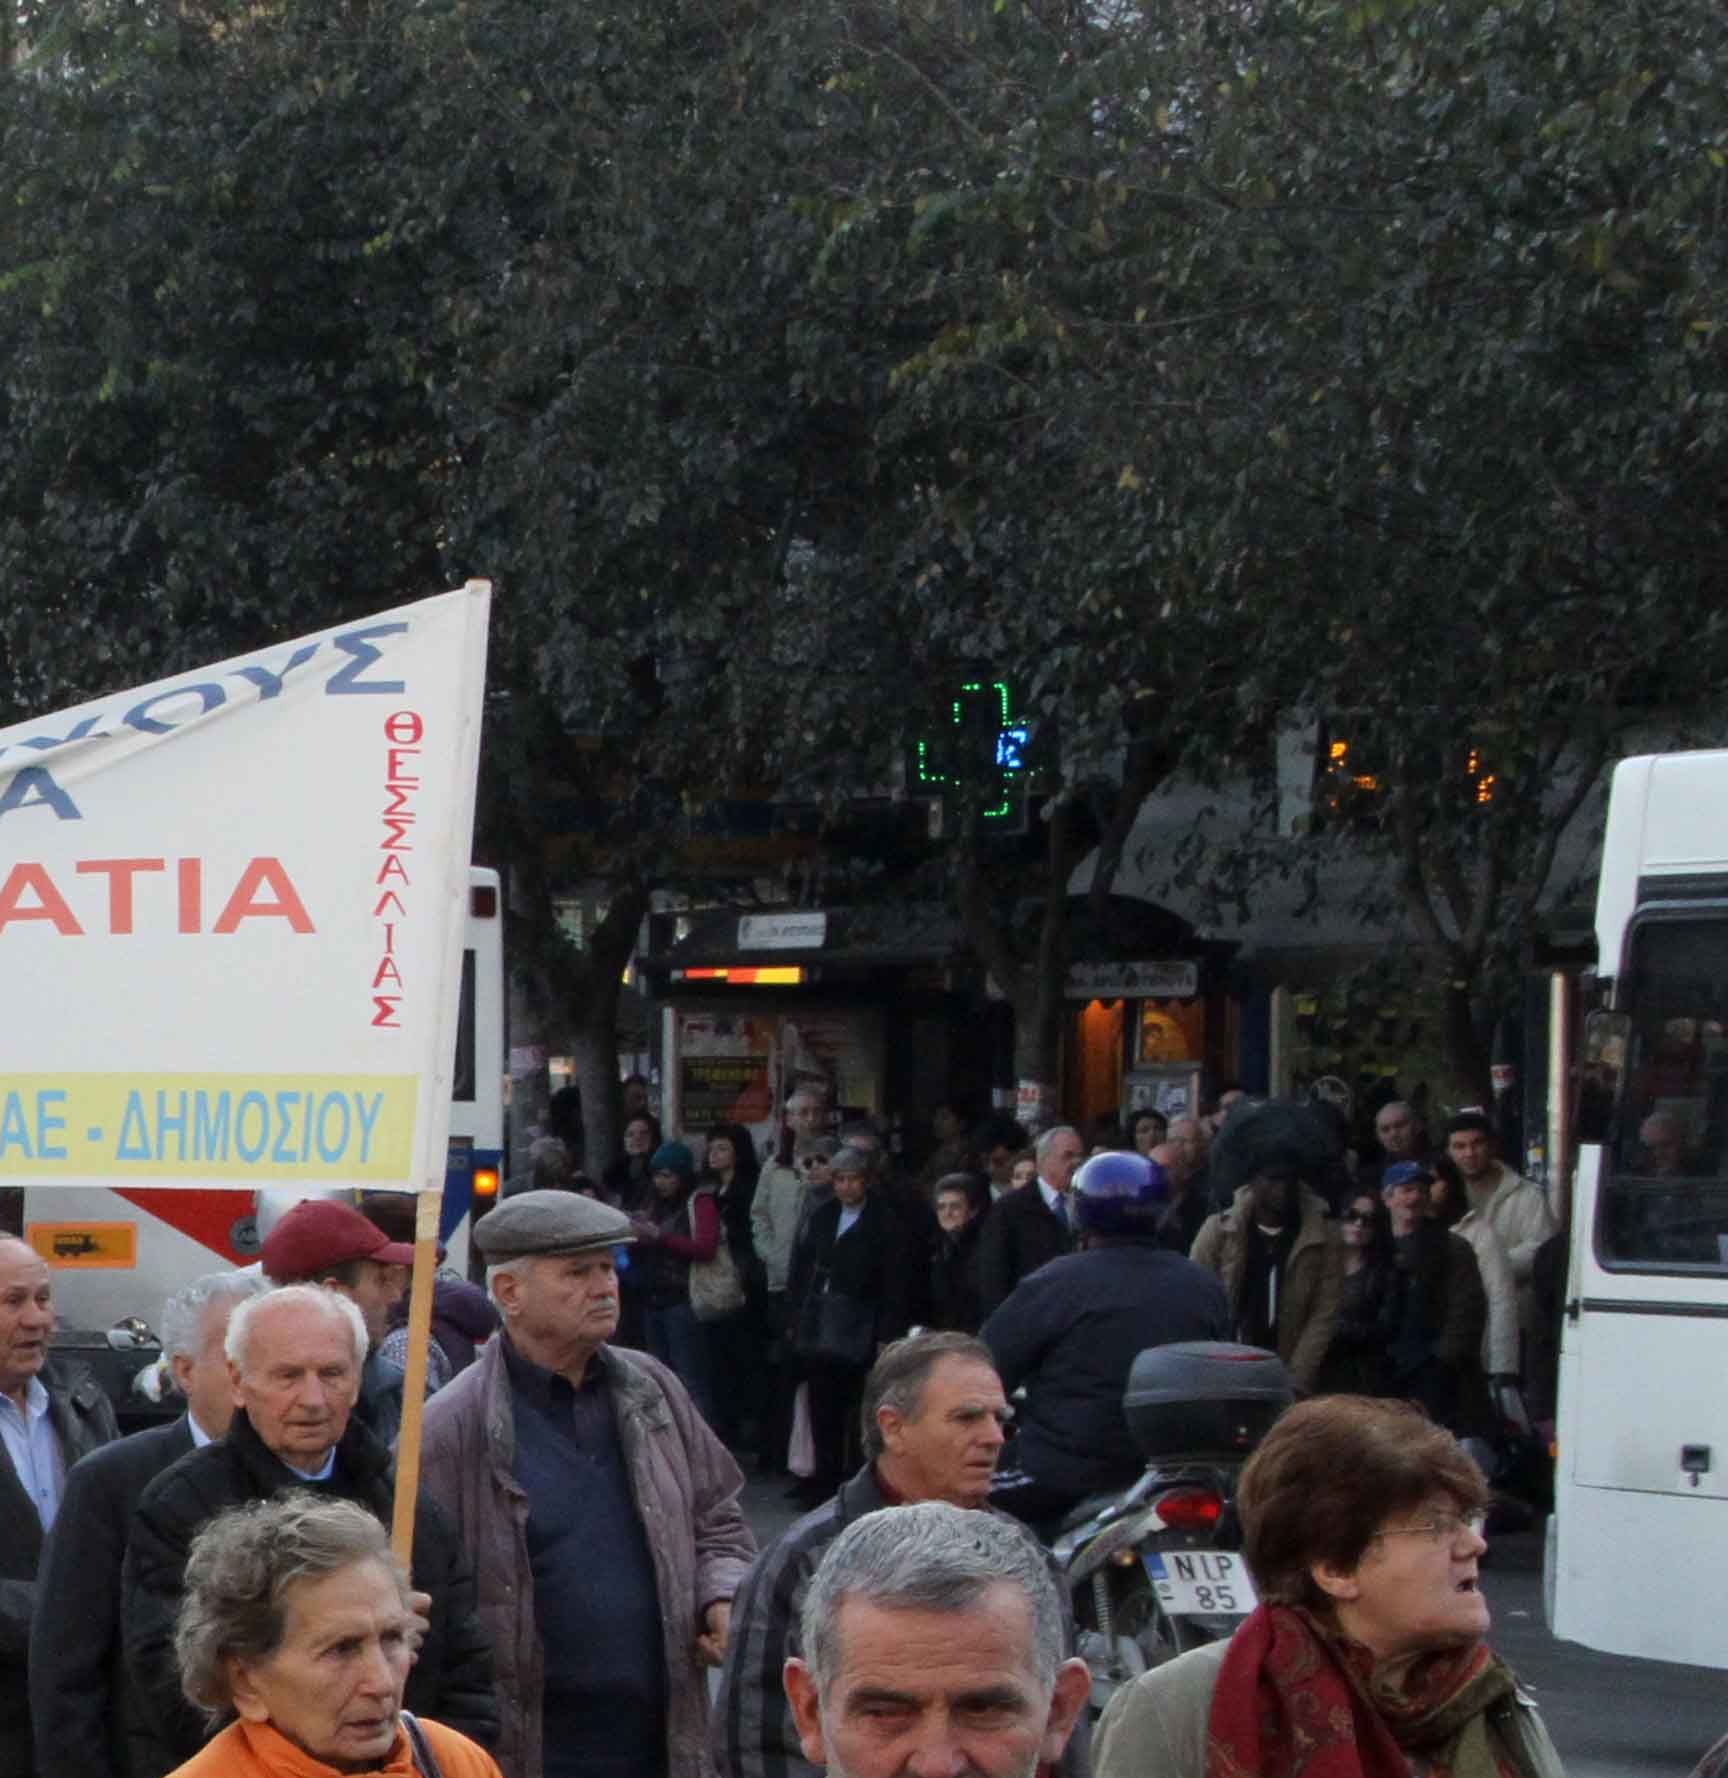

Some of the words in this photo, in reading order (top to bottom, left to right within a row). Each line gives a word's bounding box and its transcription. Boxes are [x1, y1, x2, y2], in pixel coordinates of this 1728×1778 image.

[370, 711, 424, 1029] ΘΕΣΣΑΛΙΑΣ
[116, 1090, 384, 1164] ΔΗΜΟΣΙΟΥ
[1194, 1584, 1237, 1611] 85
